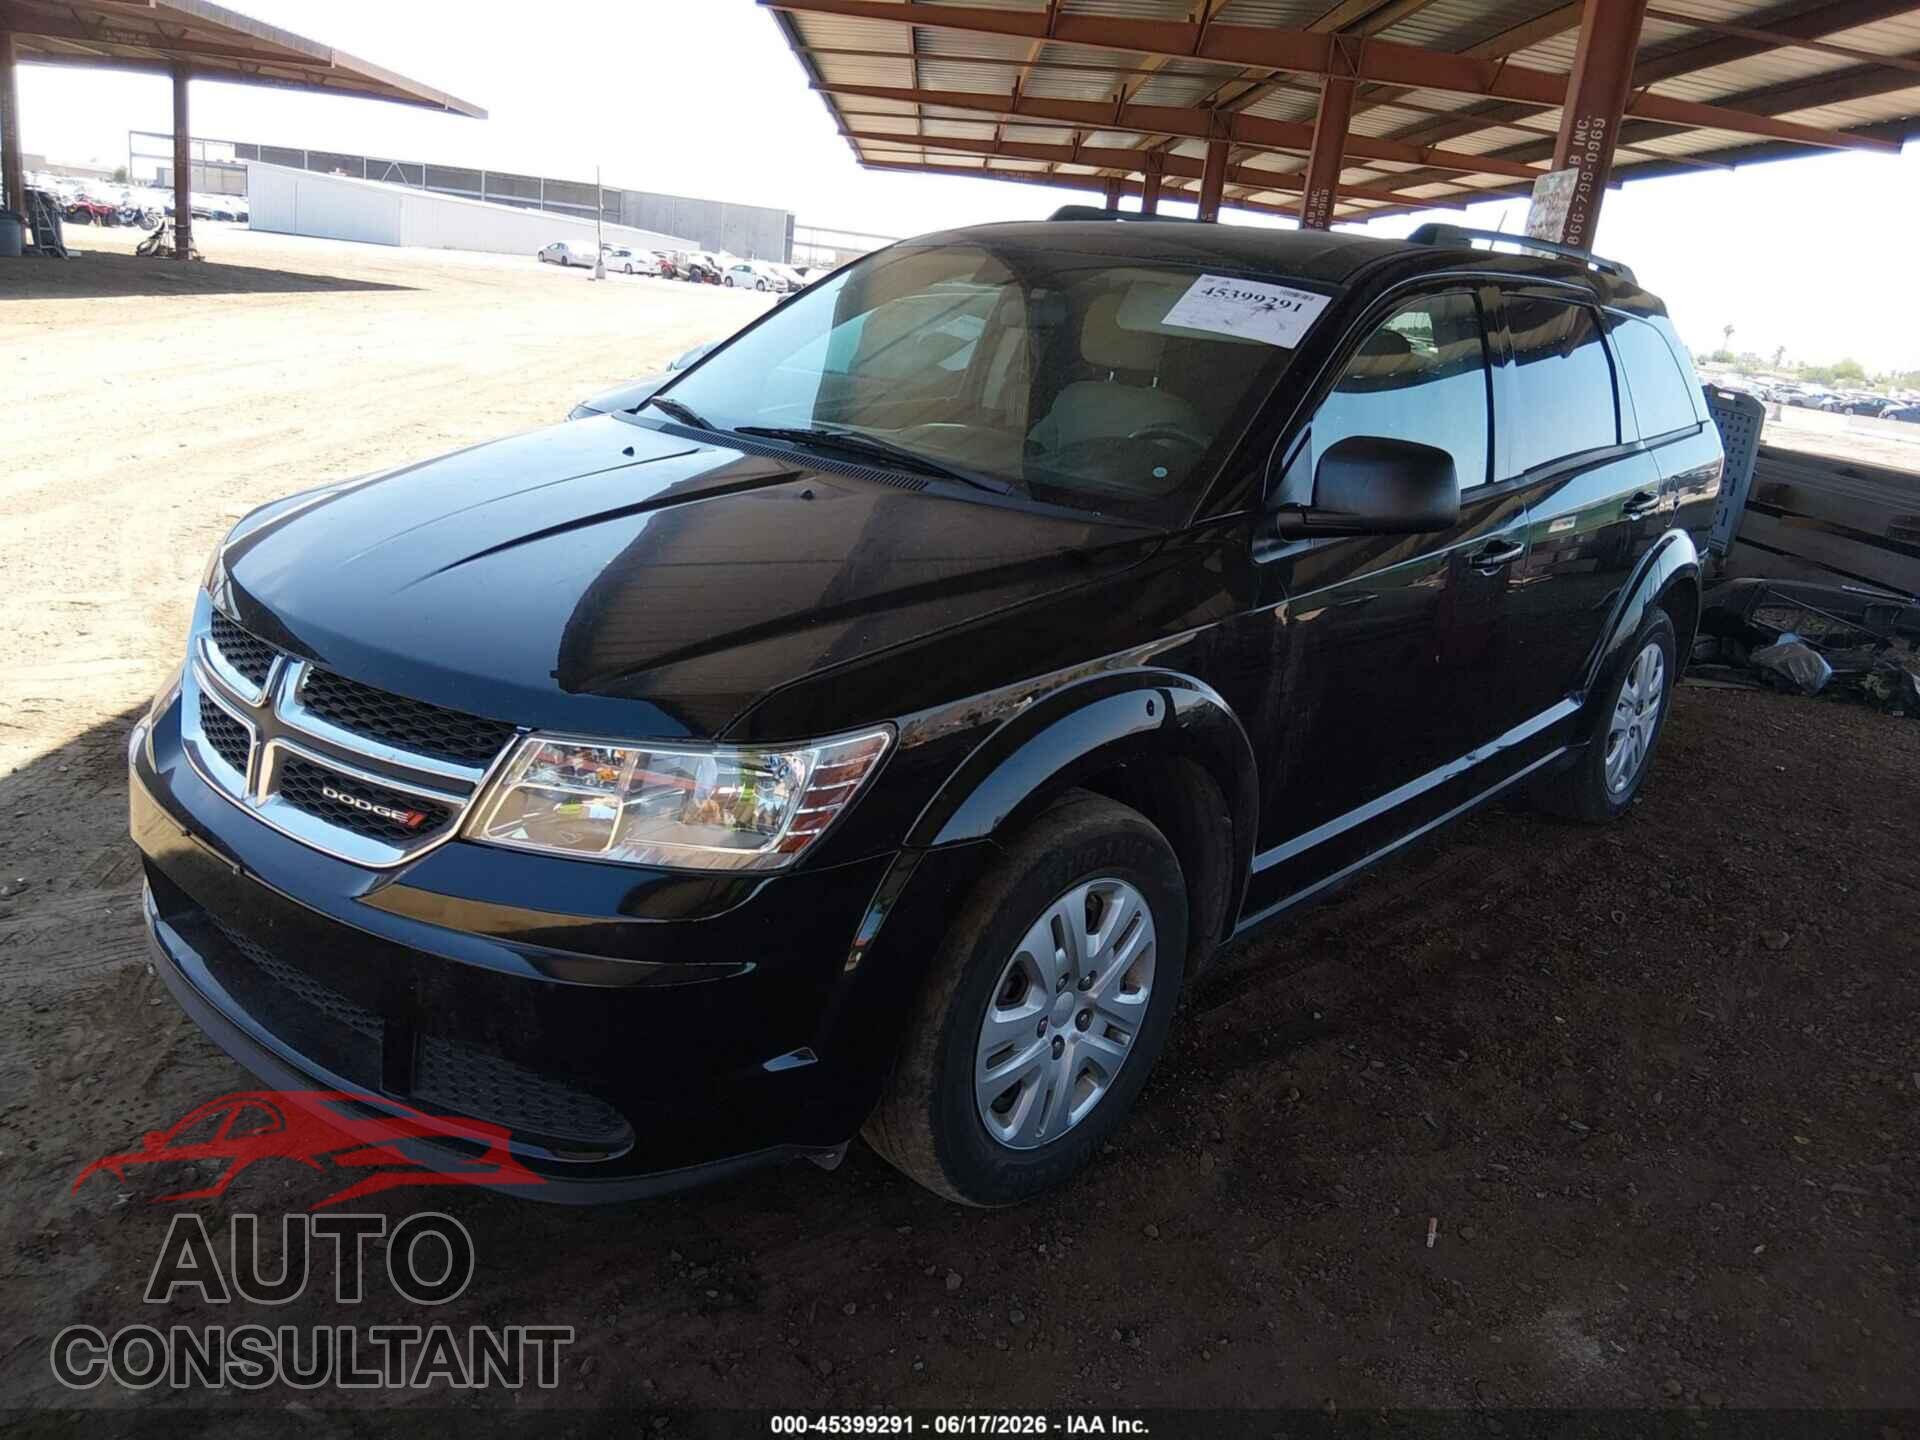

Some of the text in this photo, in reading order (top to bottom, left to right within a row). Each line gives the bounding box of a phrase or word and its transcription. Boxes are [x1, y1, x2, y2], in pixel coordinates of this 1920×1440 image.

[1573, 115, 1591, 147] INC.
[1201, 286, 1304, 313] 45399291
[322, 786, 409, 823] DODGE
